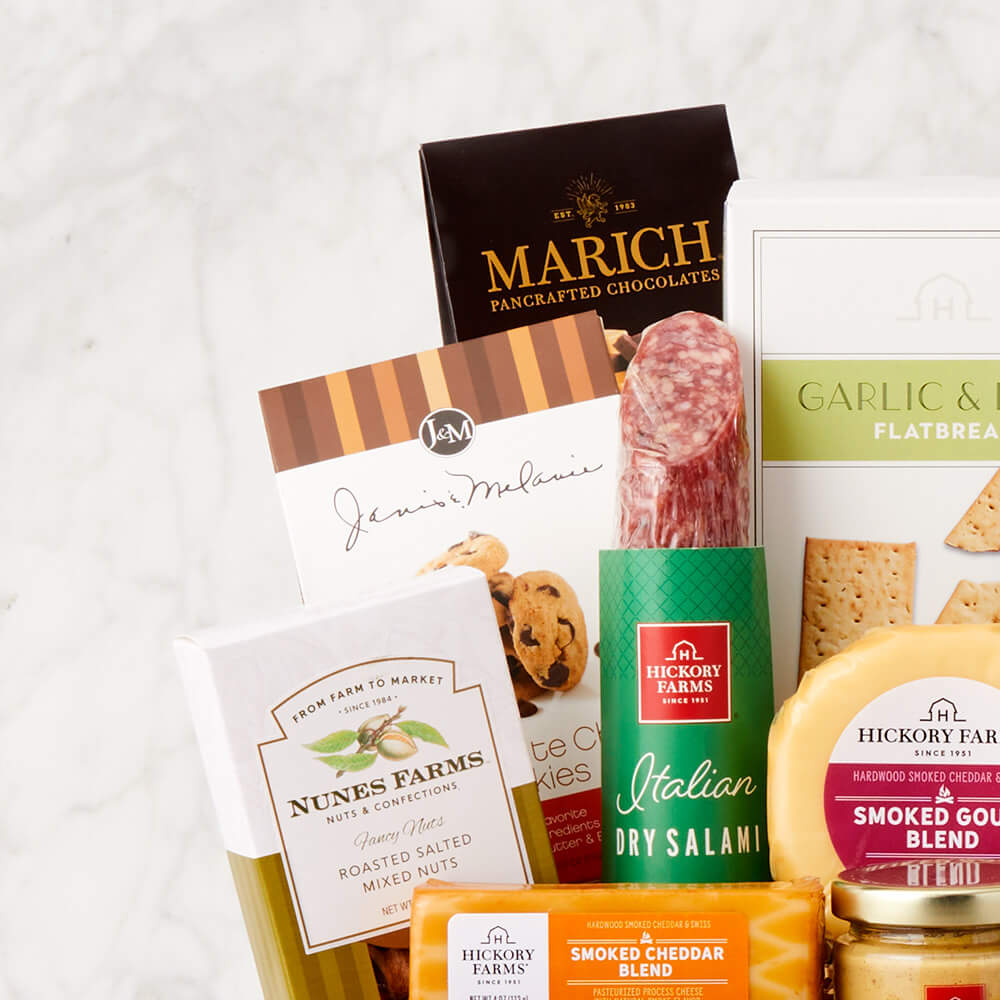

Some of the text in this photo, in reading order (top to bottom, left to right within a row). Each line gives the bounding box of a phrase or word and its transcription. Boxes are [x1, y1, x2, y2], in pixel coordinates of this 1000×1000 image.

[481, 220, 717, 293] MARICH
[491, 268, 721, 312] PANCRAFTED CHOCOLATES
[798, 381, 943, 412] GARLIC
[957, 382, 980, 412] &
[425, 418, 473, 450] J&M
[445, 454, 603, 506] Melanie
[646, 665, 722, 679] HICKORY
[657, 679, 713, 693] FARMS
[292, 675, 444, 724] FROM FARM TO MARKET
[344, 702, 370, 714] SINCE
[857, 728, 954, 744] HICKORY
[287, 751, 484, 818] NUNES FARMS
[616, 752, 758, 815] Italian
[853, 770, 905, 783] HARDWOOD
[908, 771, 946, 783] SMOKED
[949, 771, 993, 783] CHEDDAR
[326, 782, 458, 825] NUTS & CONFECTIONS
[853, 806, 949, 826] SMOKED
[354, 816, 445, 851] Fancy Nuts
[616, 825, 760, 857] DRY SALAMI
[906, 830, 980, 849] BLEND
[339, 833, 472, 880] ROASTED SALTED
[362, 857, 459, 893] MIXED NUTS
[382, 904, 398, 916] NET
[586, 920, 623, 929] HARDWOOD
[625, 920, 651, 929] SMOKED
[653, 920, 683, 928] CHEDDAR
[462, 949, 535, 961] HICKORY
[570, 946, 725, 961] SMOKED CHEDDAR
[472, 963, 525, 975] FARMS
[619, 963, 673, 977] BLEND
[593, 987, 703, 997] PASTEURIZED PROCESS CHEESE
